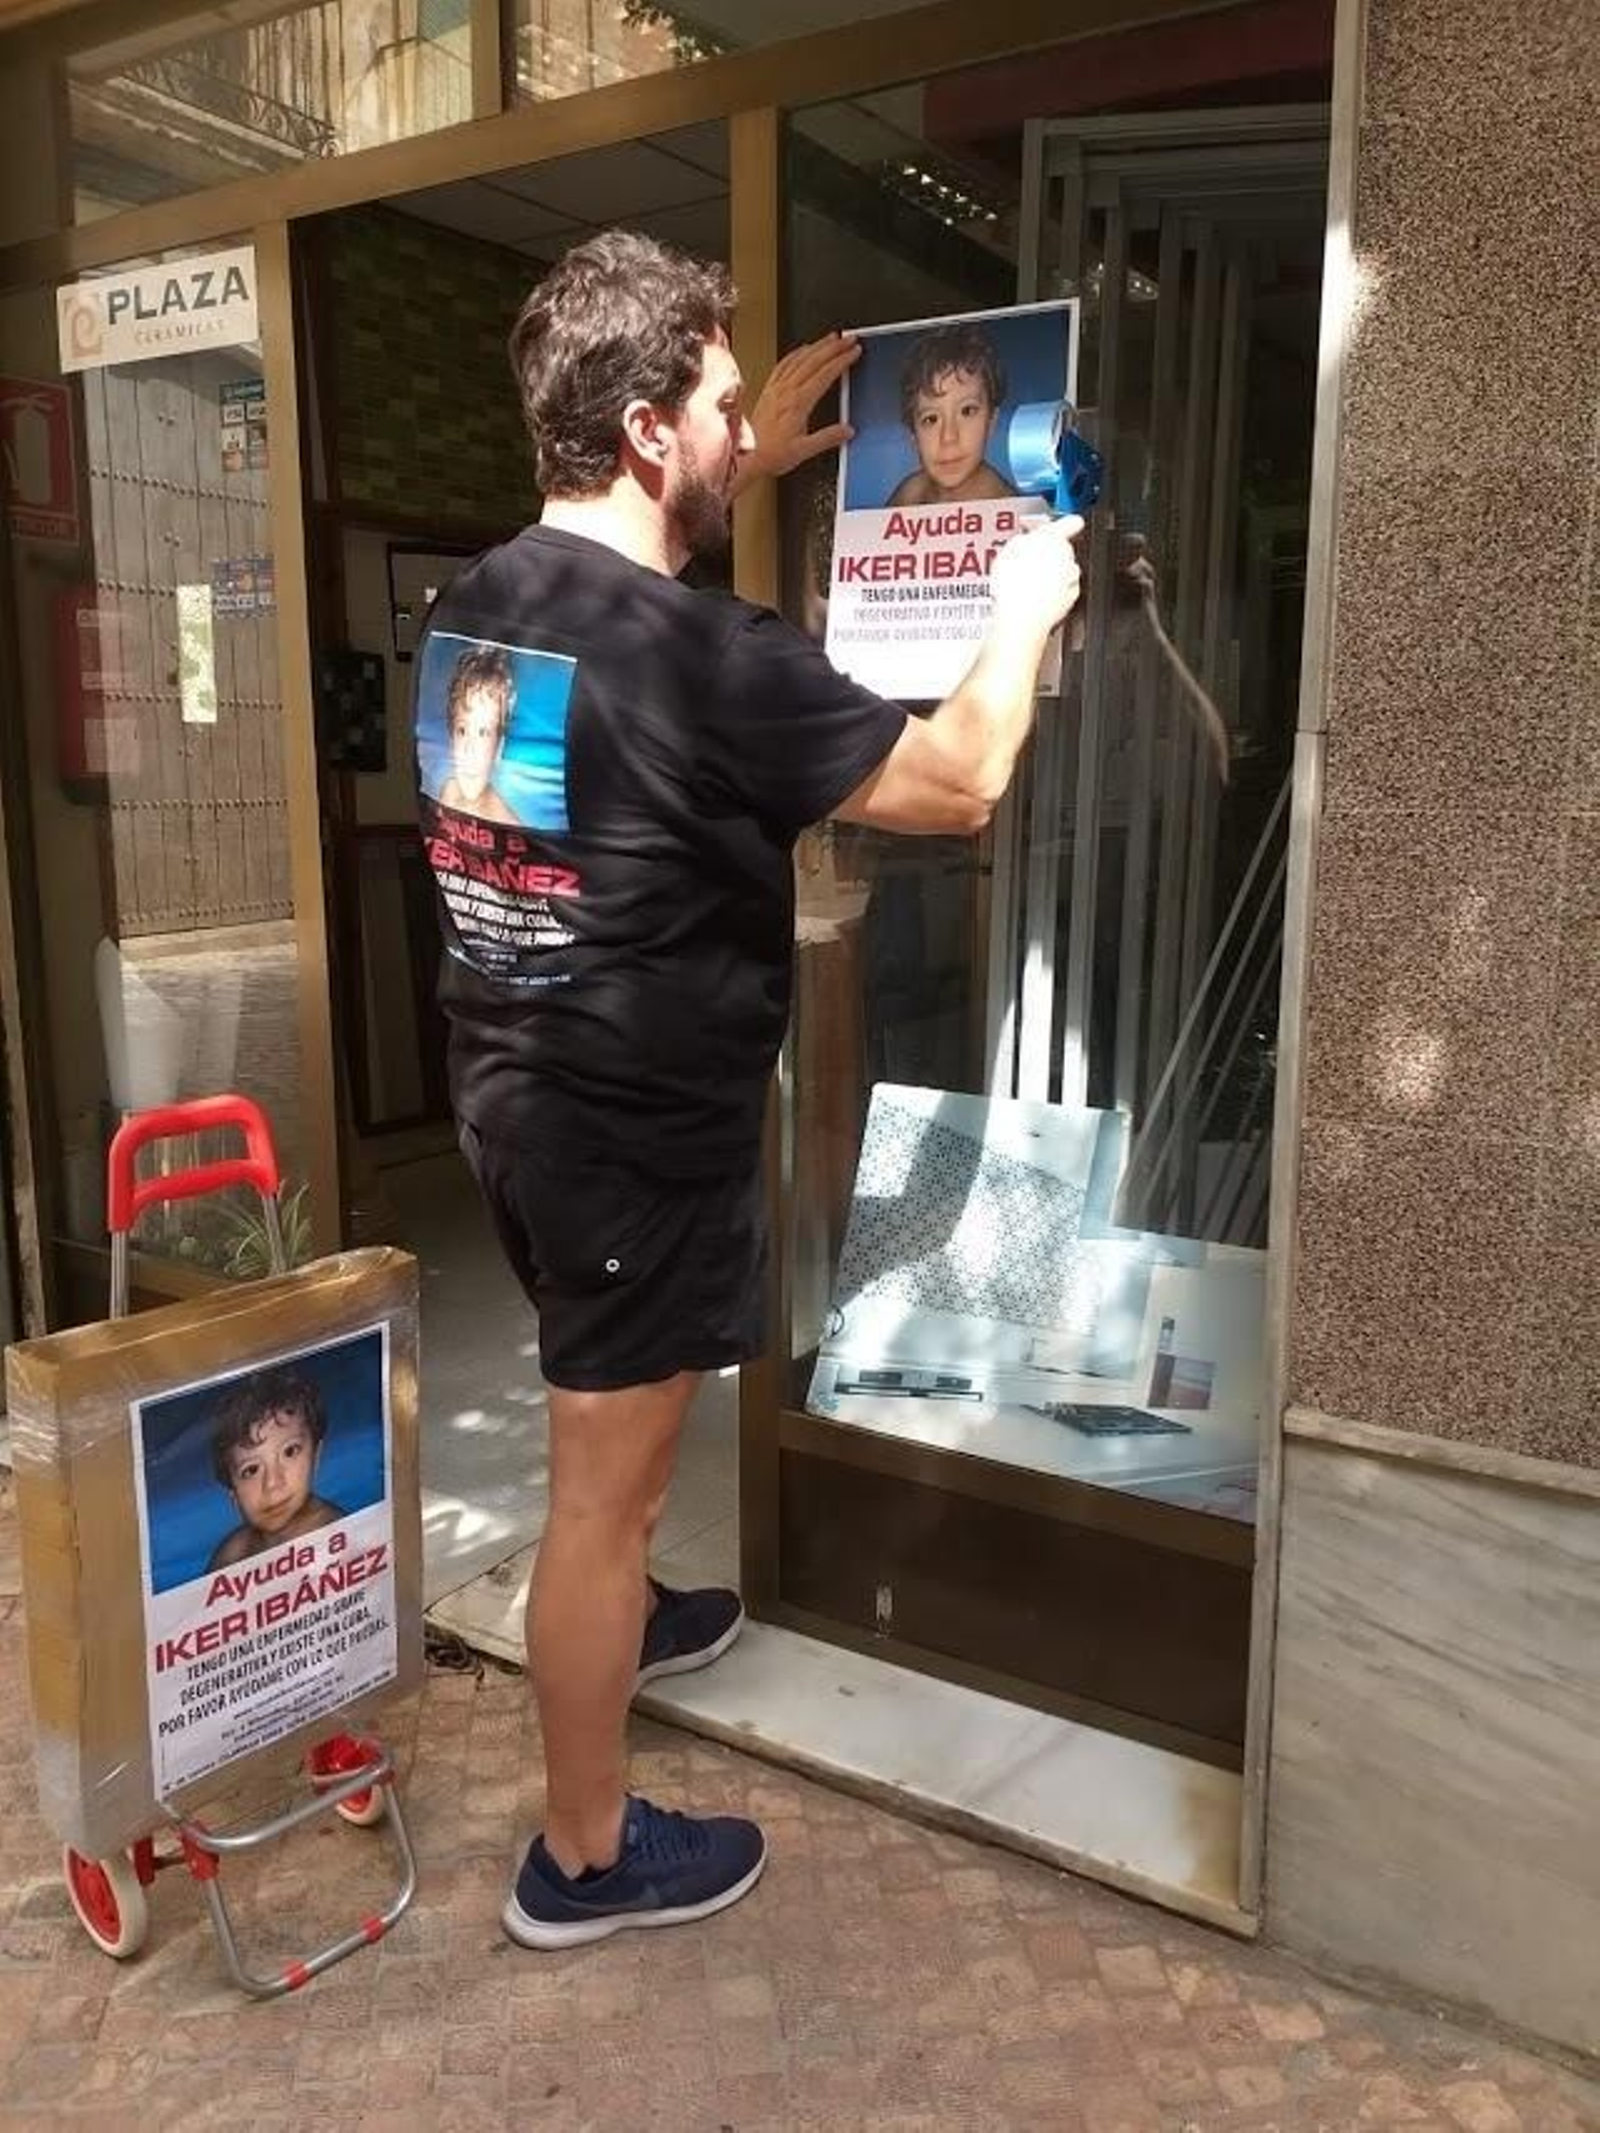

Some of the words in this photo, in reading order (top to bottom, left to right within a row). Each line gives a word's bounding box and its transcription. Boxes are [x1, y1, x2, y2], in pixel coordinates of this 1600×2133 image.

[107, 266, 250, 325] PLAZA
[883, 507, 982, 545] Ayuda
[996, 511, 1014, 531] a
[838, 553, 917, 583] IKER
[861, 587, 895, 602] TENGO
[898, 586, 920, 602] UNA
[205, 1546, 315, 1607] Ayuda
[328, 1531, 346, 1555] a
[156, 1611, 249, 1673] IKER
[256, 1544, 388, 1630] IBÁÑEZ
[188, 1651, 227, 1681] TENGO
[229, 1639, 254, 1662] UNA
[257, 1604, 330, 1650] ENFERMEDAD
[334, 1587, 365, 1614] GRAVE
[158, 1713, 186, 1738] POR
[187, 1693, 227, 1725] FAVOR
[286, 1654, 307, 1677] CON
[311, 1648, 322, 1666] LO
[326, 1636, 347, 1658] QUE
[180, 1653, 267, 1707] DEGENERATIVA
[270, 1649, 278, 1664] Y
[279, 1631, 315, 1660] EXISTE
[317, 1621, 340, 1642] UNA
